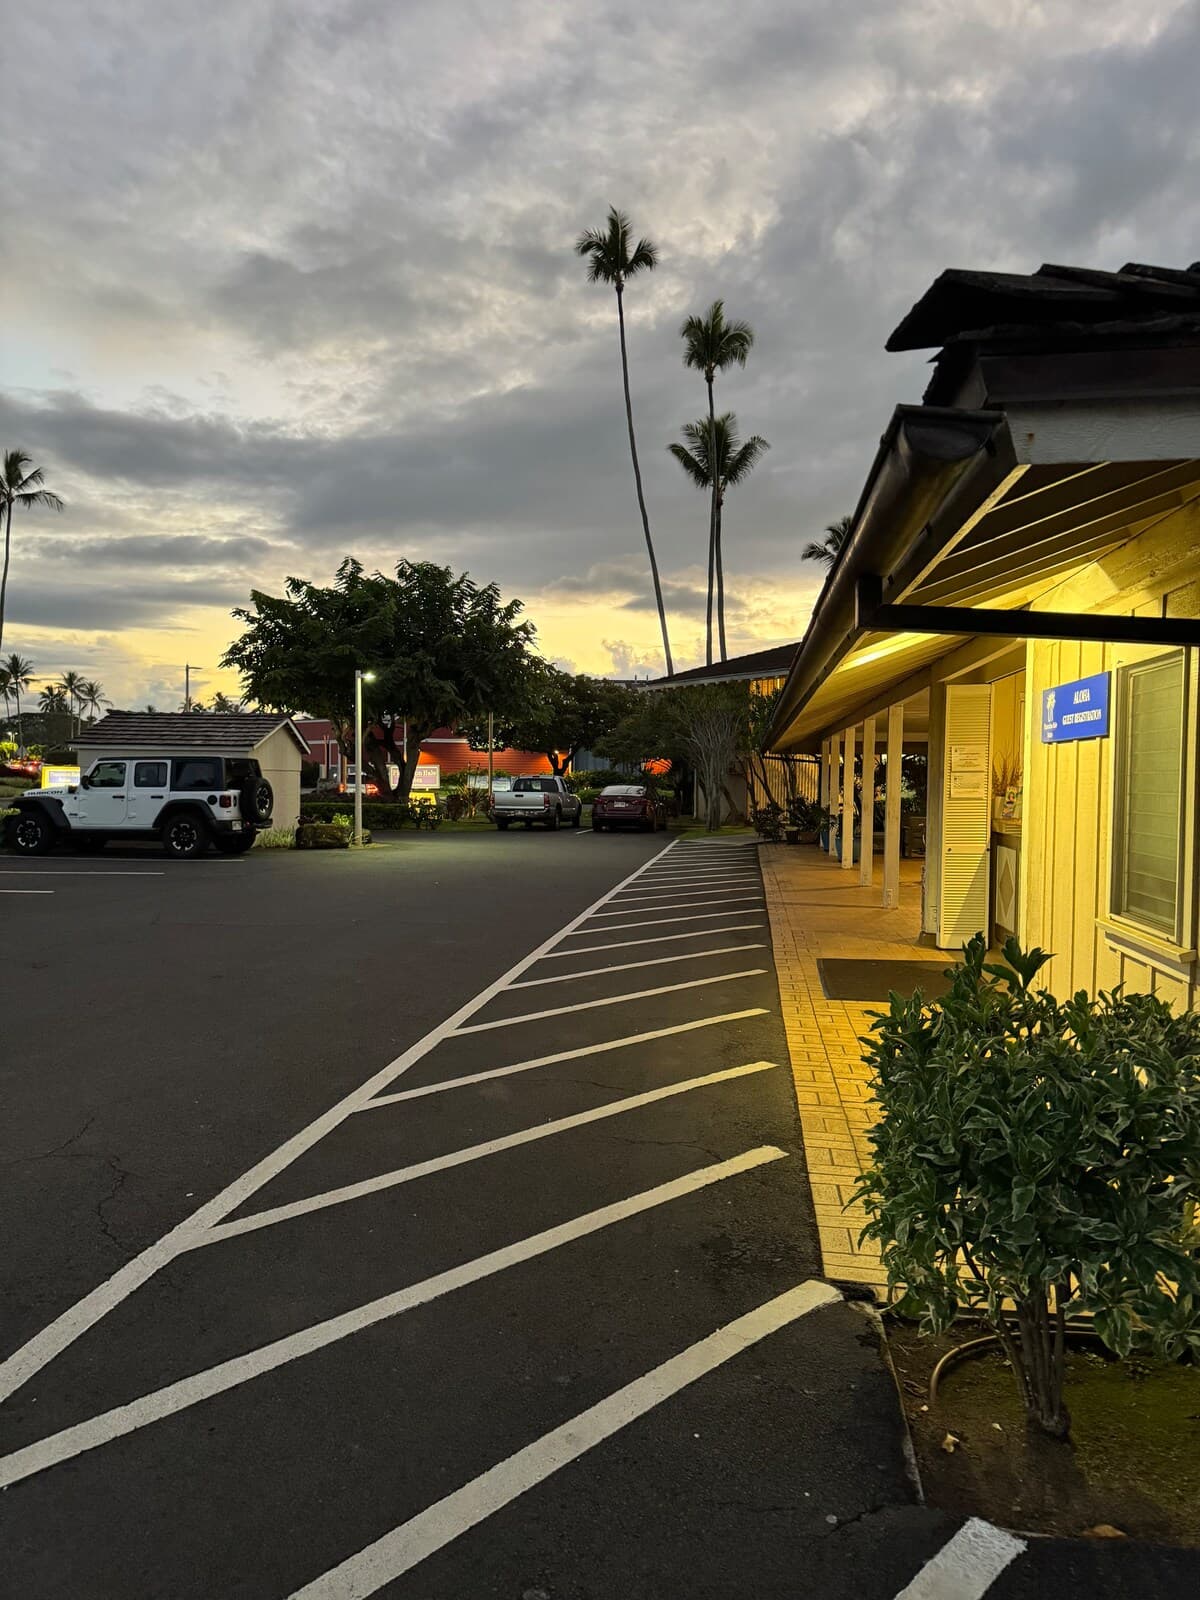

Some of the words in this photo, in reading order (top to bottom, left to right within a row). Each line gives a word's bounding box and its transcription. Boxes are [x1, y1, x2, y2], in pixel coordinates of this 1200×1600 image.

[1073, 688, 1090, 704] ALOHA
[1062, 713, 1073, 726] GUEST
[1074, 709, 1102, 722] REGISTRATION
